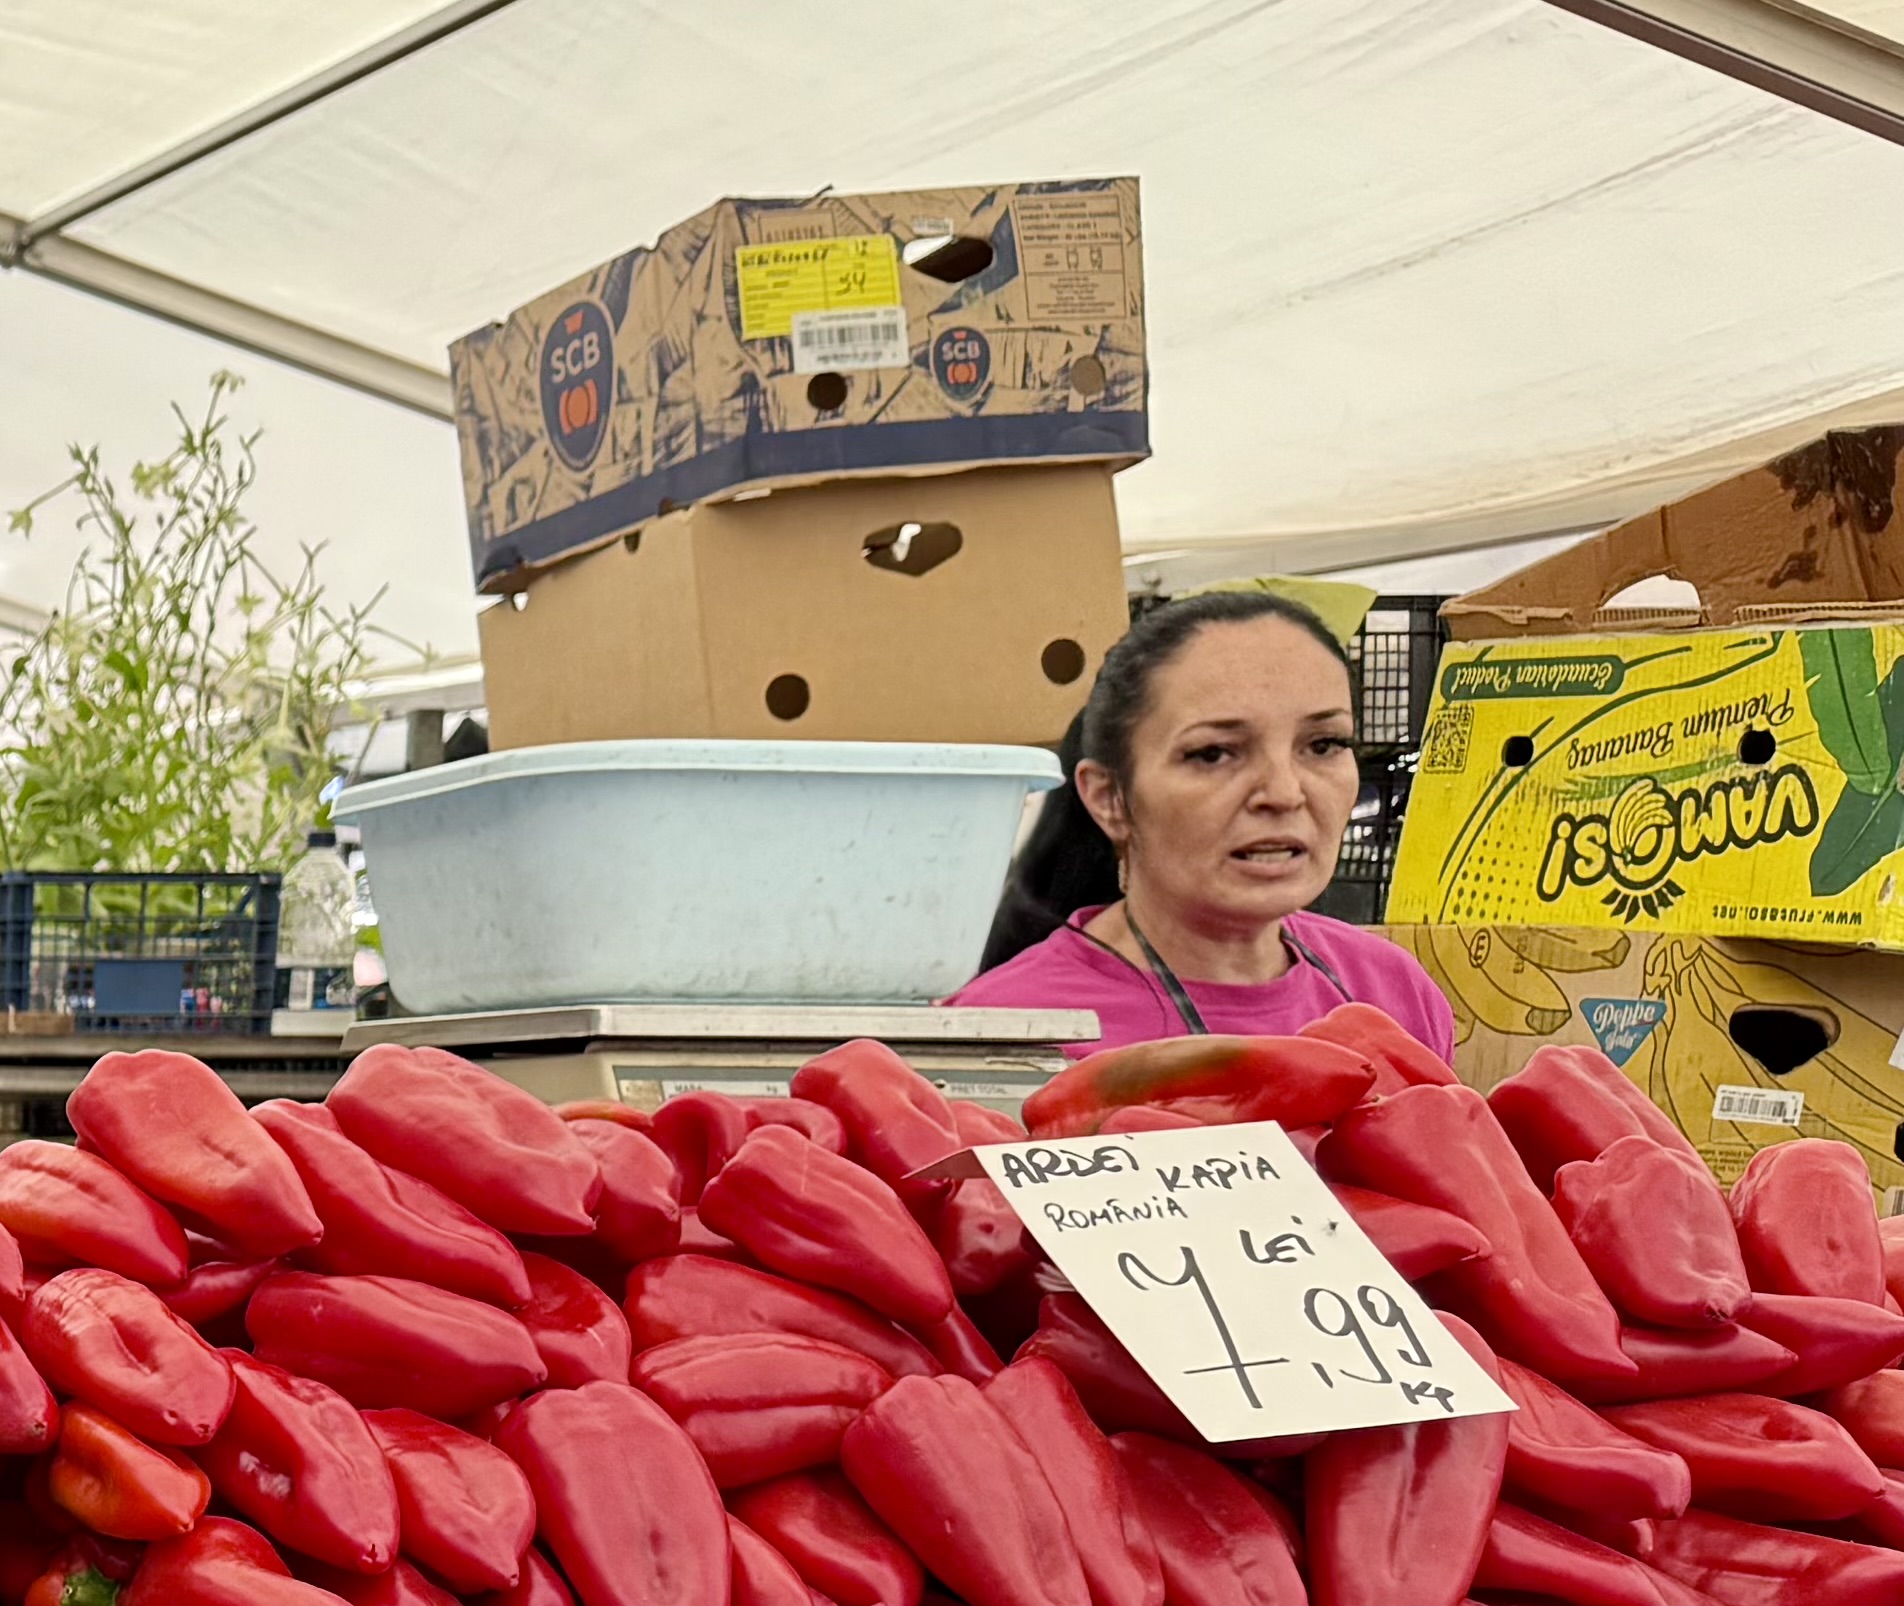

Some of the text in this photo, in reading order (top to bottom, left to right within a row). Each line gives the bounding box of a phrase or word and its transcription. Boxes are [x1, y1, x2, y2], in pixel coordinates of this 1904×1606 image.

[549, 331, 601, 384] SCB
[942, 340, 981, 362] SCB
[1451, 661, 1614, 696] Ecuadorian Product
[1566, 687, 1796, 772] Premium Bananas
